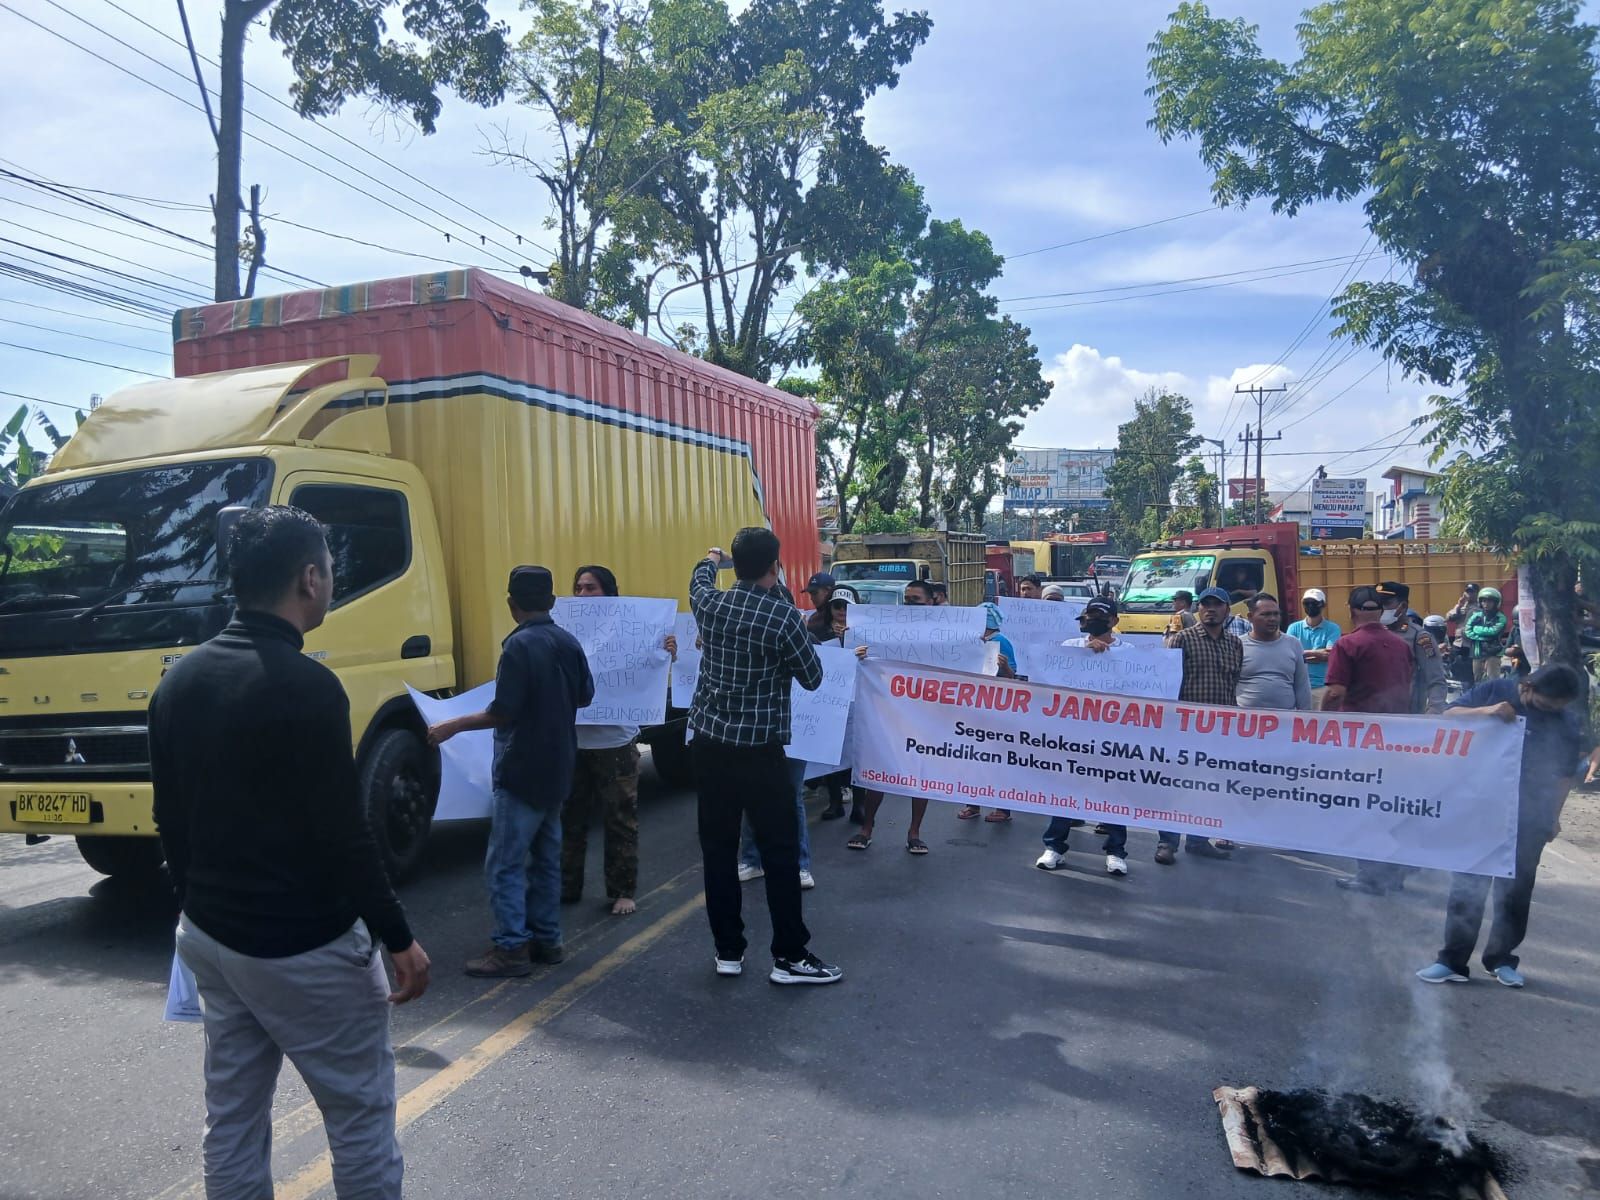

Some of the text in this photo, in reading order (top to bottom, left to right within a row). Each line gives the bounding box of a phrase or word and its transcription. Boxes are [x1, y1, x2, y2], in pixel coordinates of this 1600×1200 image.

[1009, 487, 1042, 500] TAHAP
[879, 564, 908, 573] RIMBA
[890, 675, 1031, 713] GUBERNUR
[1042, 693, 1164, 729] JANGAN
[1176, 708, 1279, 739] TUTUP
[905, 738, 1442, 818] Pendidikan Bukan Tempat Wacana Kepentingan Politik!
[955, 722, 1383, 785] Segera Relokasi SMA N. 5 Pematangsiantar!
[19, 795, 87, 813] BK 8247 HD
[921, 776, 954, 795] yang
[957, 781, 995, 799] layak
[999, 788, 1047, 805] adalah
[1050, 793, 1080, 810] hak,
[1084, 798, 1130, 816] bukan
[1134, 807, 1222, 829] permintaan
